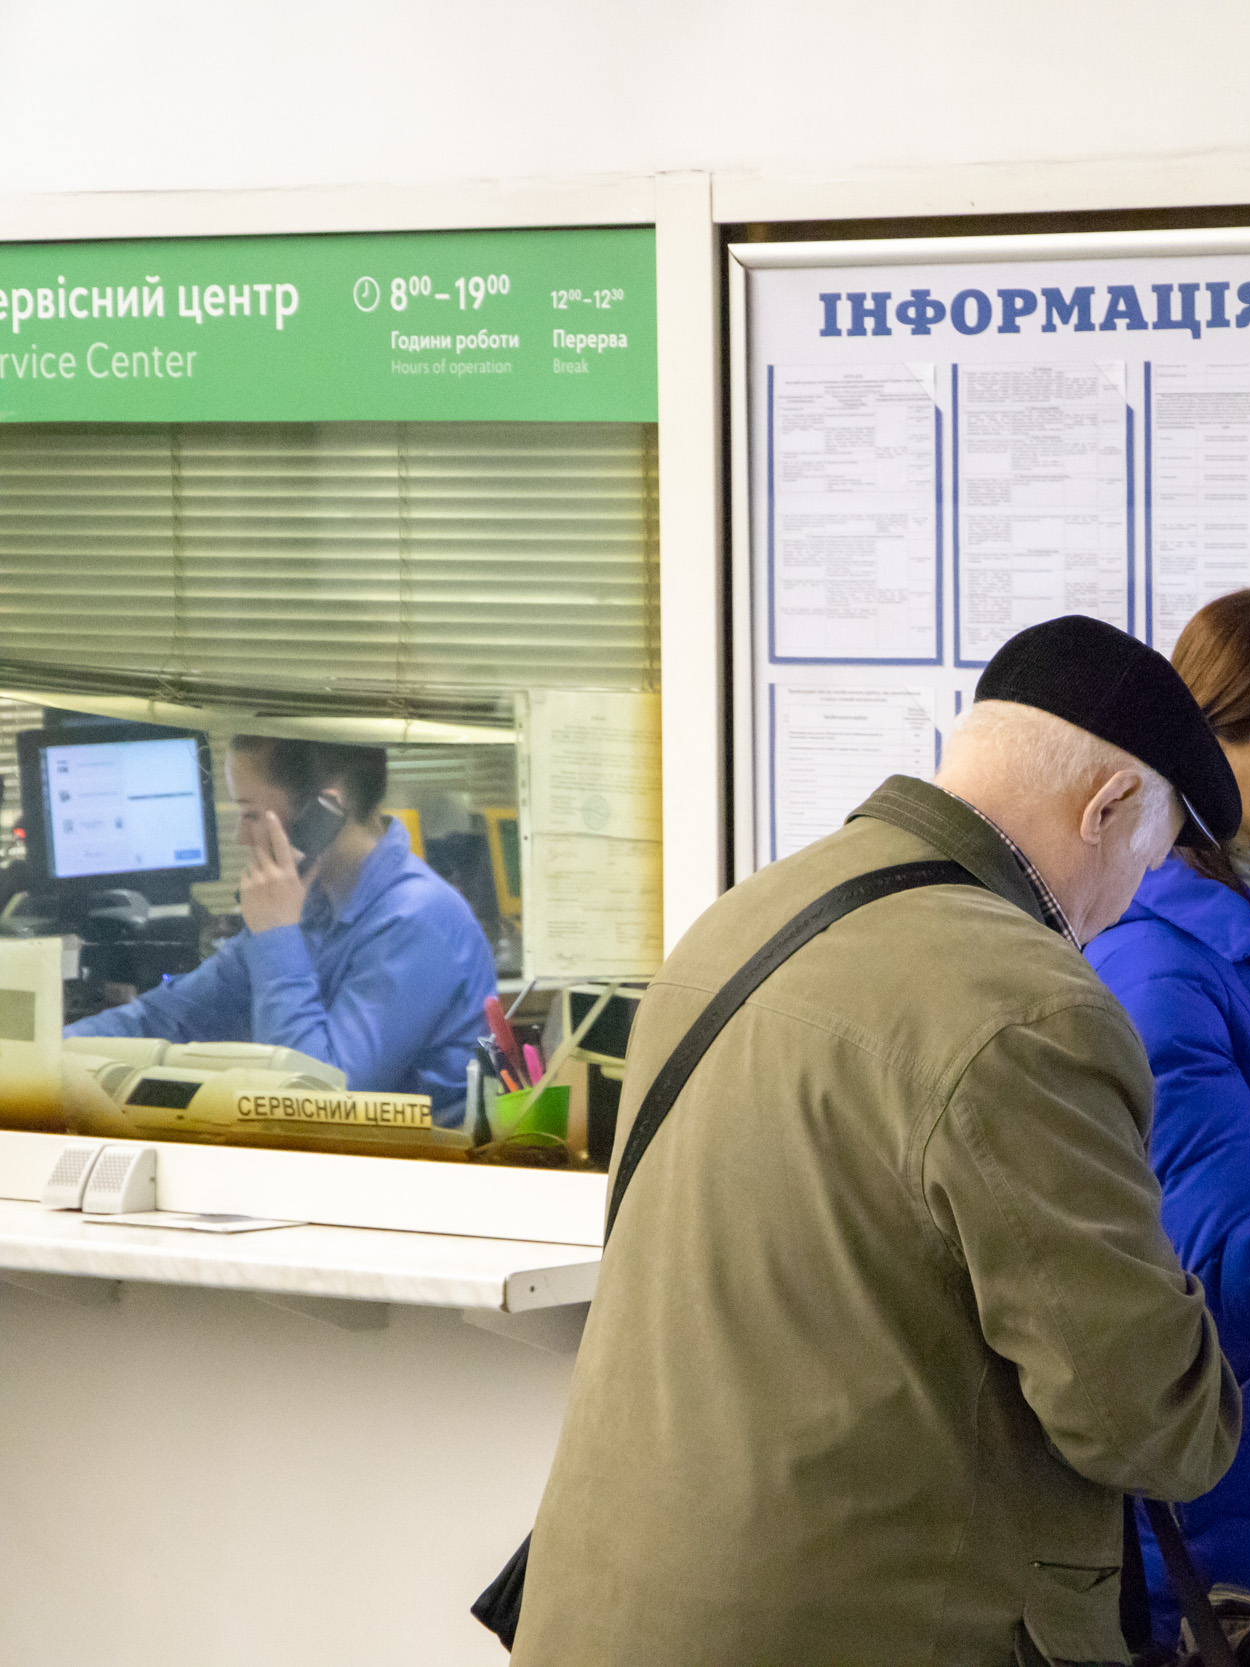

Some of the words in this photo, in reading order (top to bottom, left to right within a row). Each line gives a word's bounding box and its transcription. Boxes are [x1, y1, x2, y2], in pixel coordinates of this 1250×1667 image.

[178, 283, 299, 331] центр
[391, 331, 450, 353] Години
[456, 329, 520, 354] роботи
[553, 329, 628, 353] Перерва
[87, 342, 198, 378] Center
[391, 360, 430, 374] Hours
[433, 358, 447, 374] of
[449, 360, 512, 378] operation
[553, 358, 589, 374] Break
[237, 1095, 357, 1122] СЕРВІСНИЙ
[363, 1100, 431, 1126] ЦЕНТР
